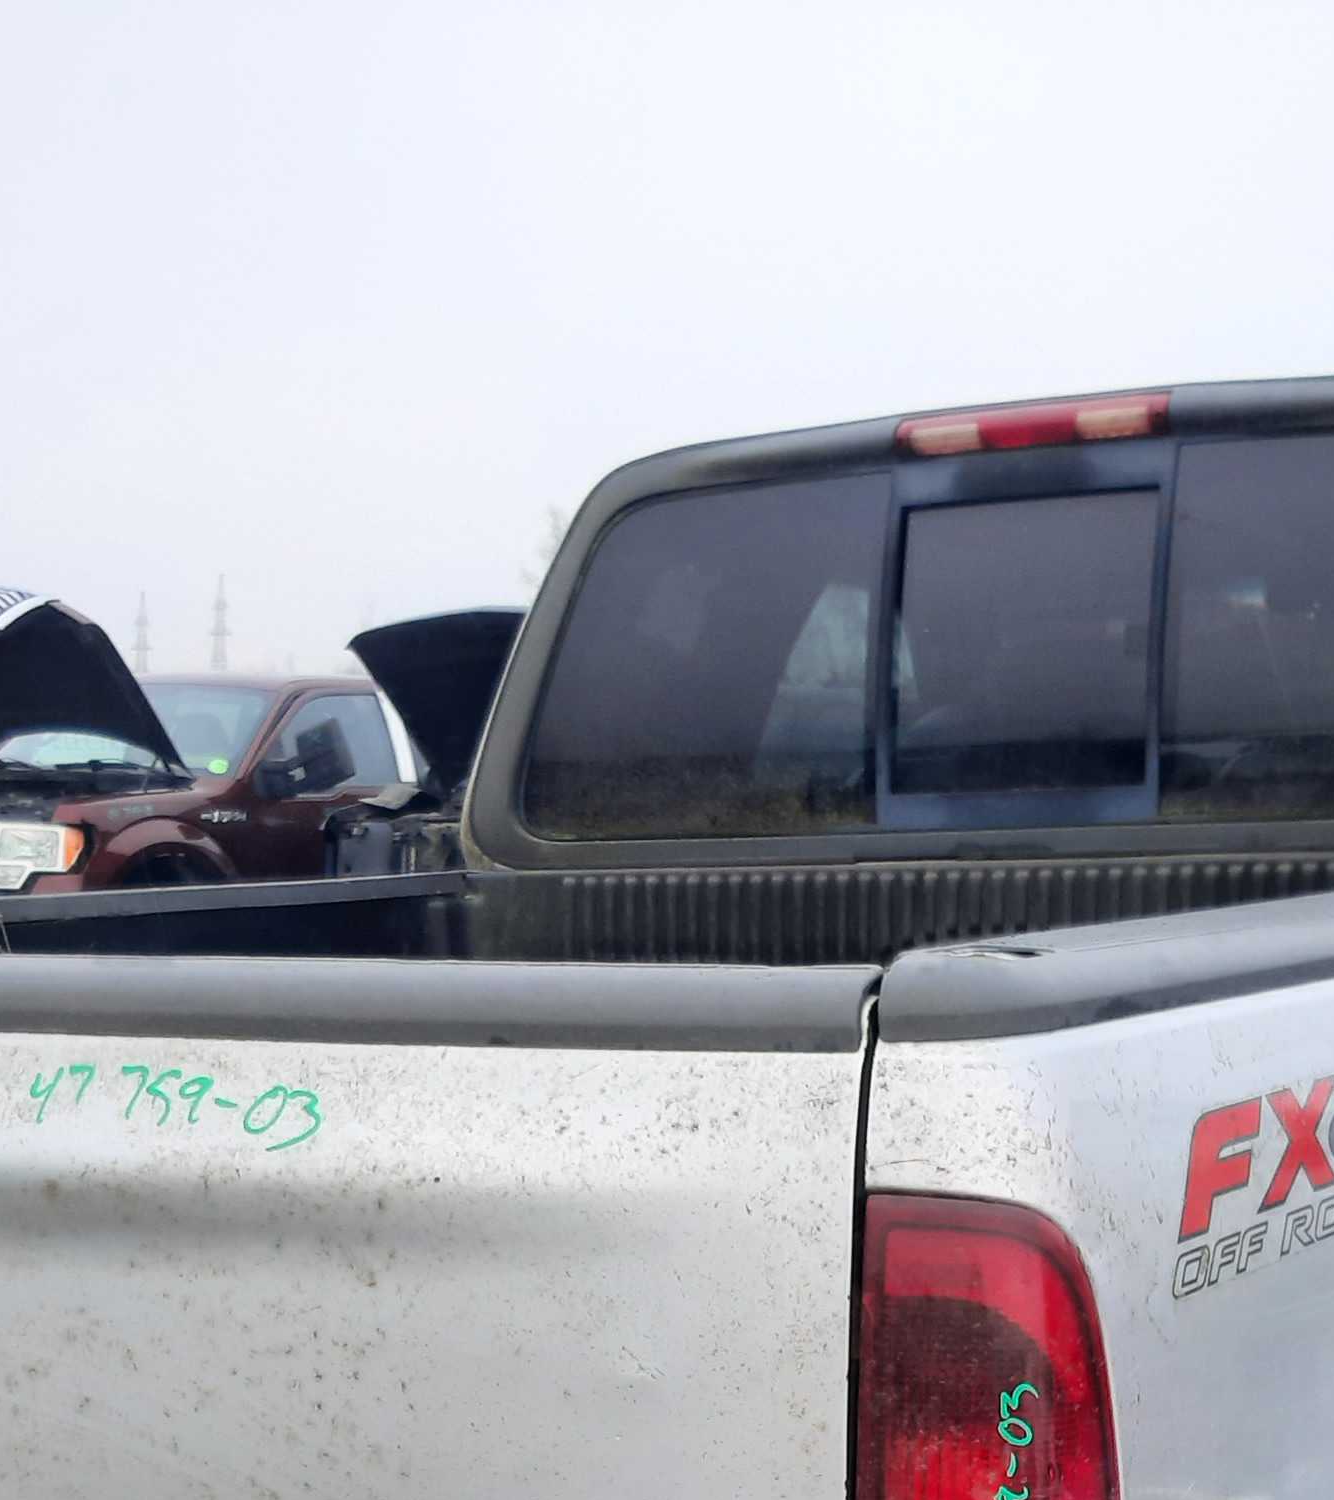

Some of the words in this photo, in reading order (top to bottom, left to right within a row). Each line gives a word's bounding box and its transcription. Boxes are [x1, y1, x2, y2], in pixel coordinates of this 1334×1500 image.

[29, 1063, 97, 1124] 47
[122, 1064, 323, 1152] 759-03
[1172, 1220, 1269, 1300] OFF
